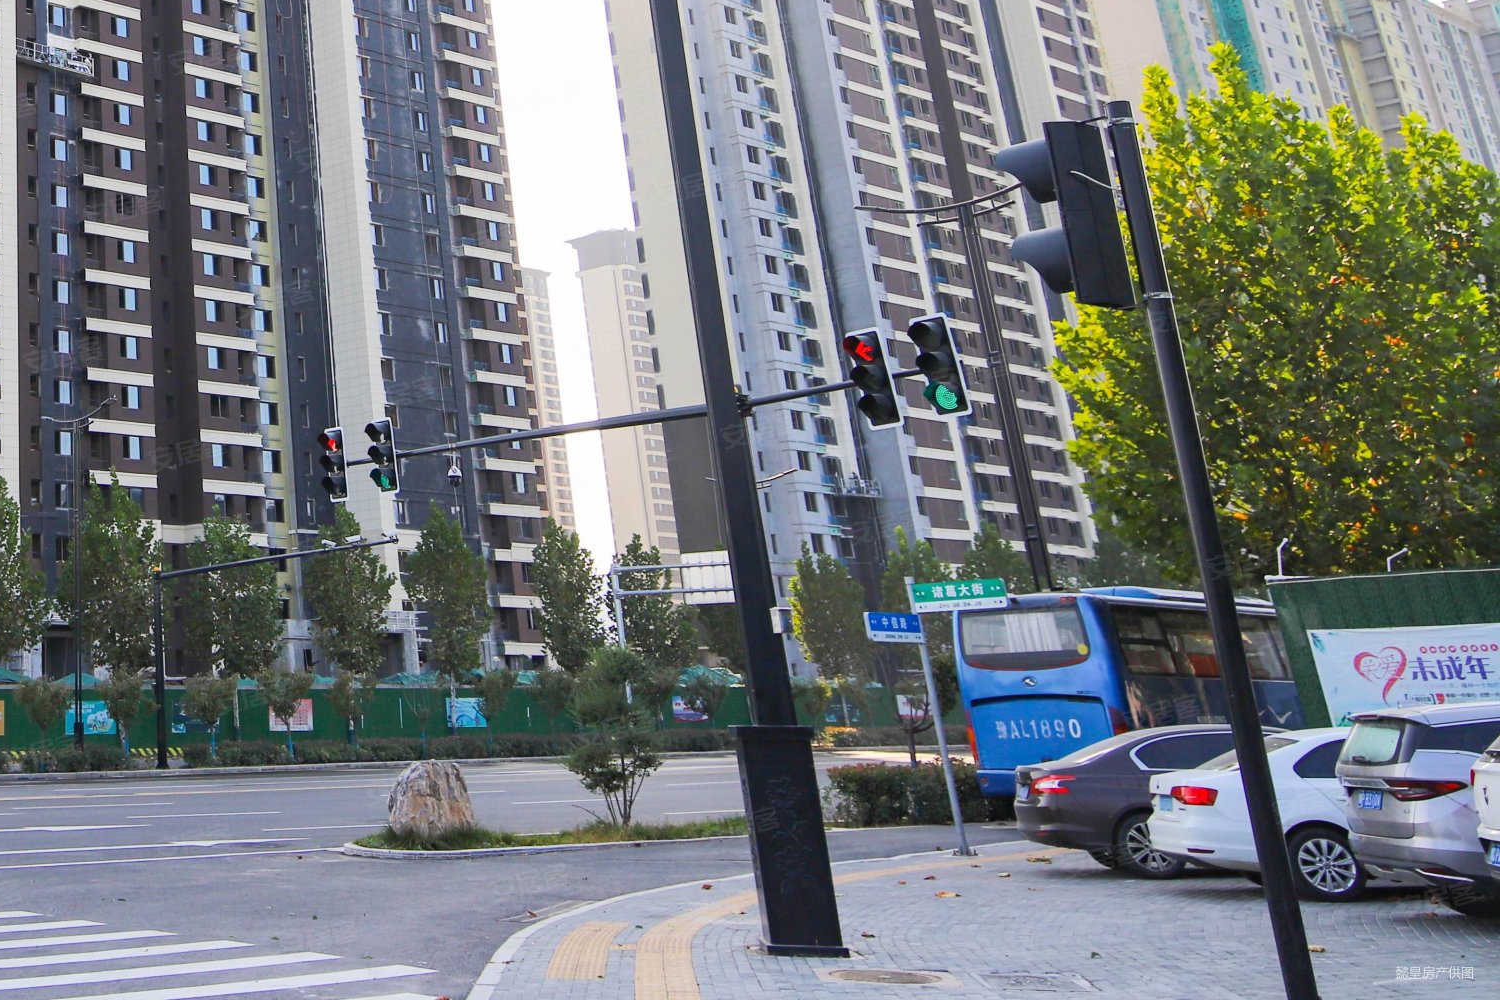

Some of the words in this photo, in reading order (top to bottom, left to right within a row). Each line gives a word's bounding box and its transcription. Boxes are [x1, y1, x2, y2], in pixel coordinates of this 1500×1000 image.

[931, 583, 984, 599] 诸葛大街
[881, 616, 907, 629] 中信路
[1408, 655, 1495, 681] 未成年
[995, 718, 1082, 739] 豫AL1890
